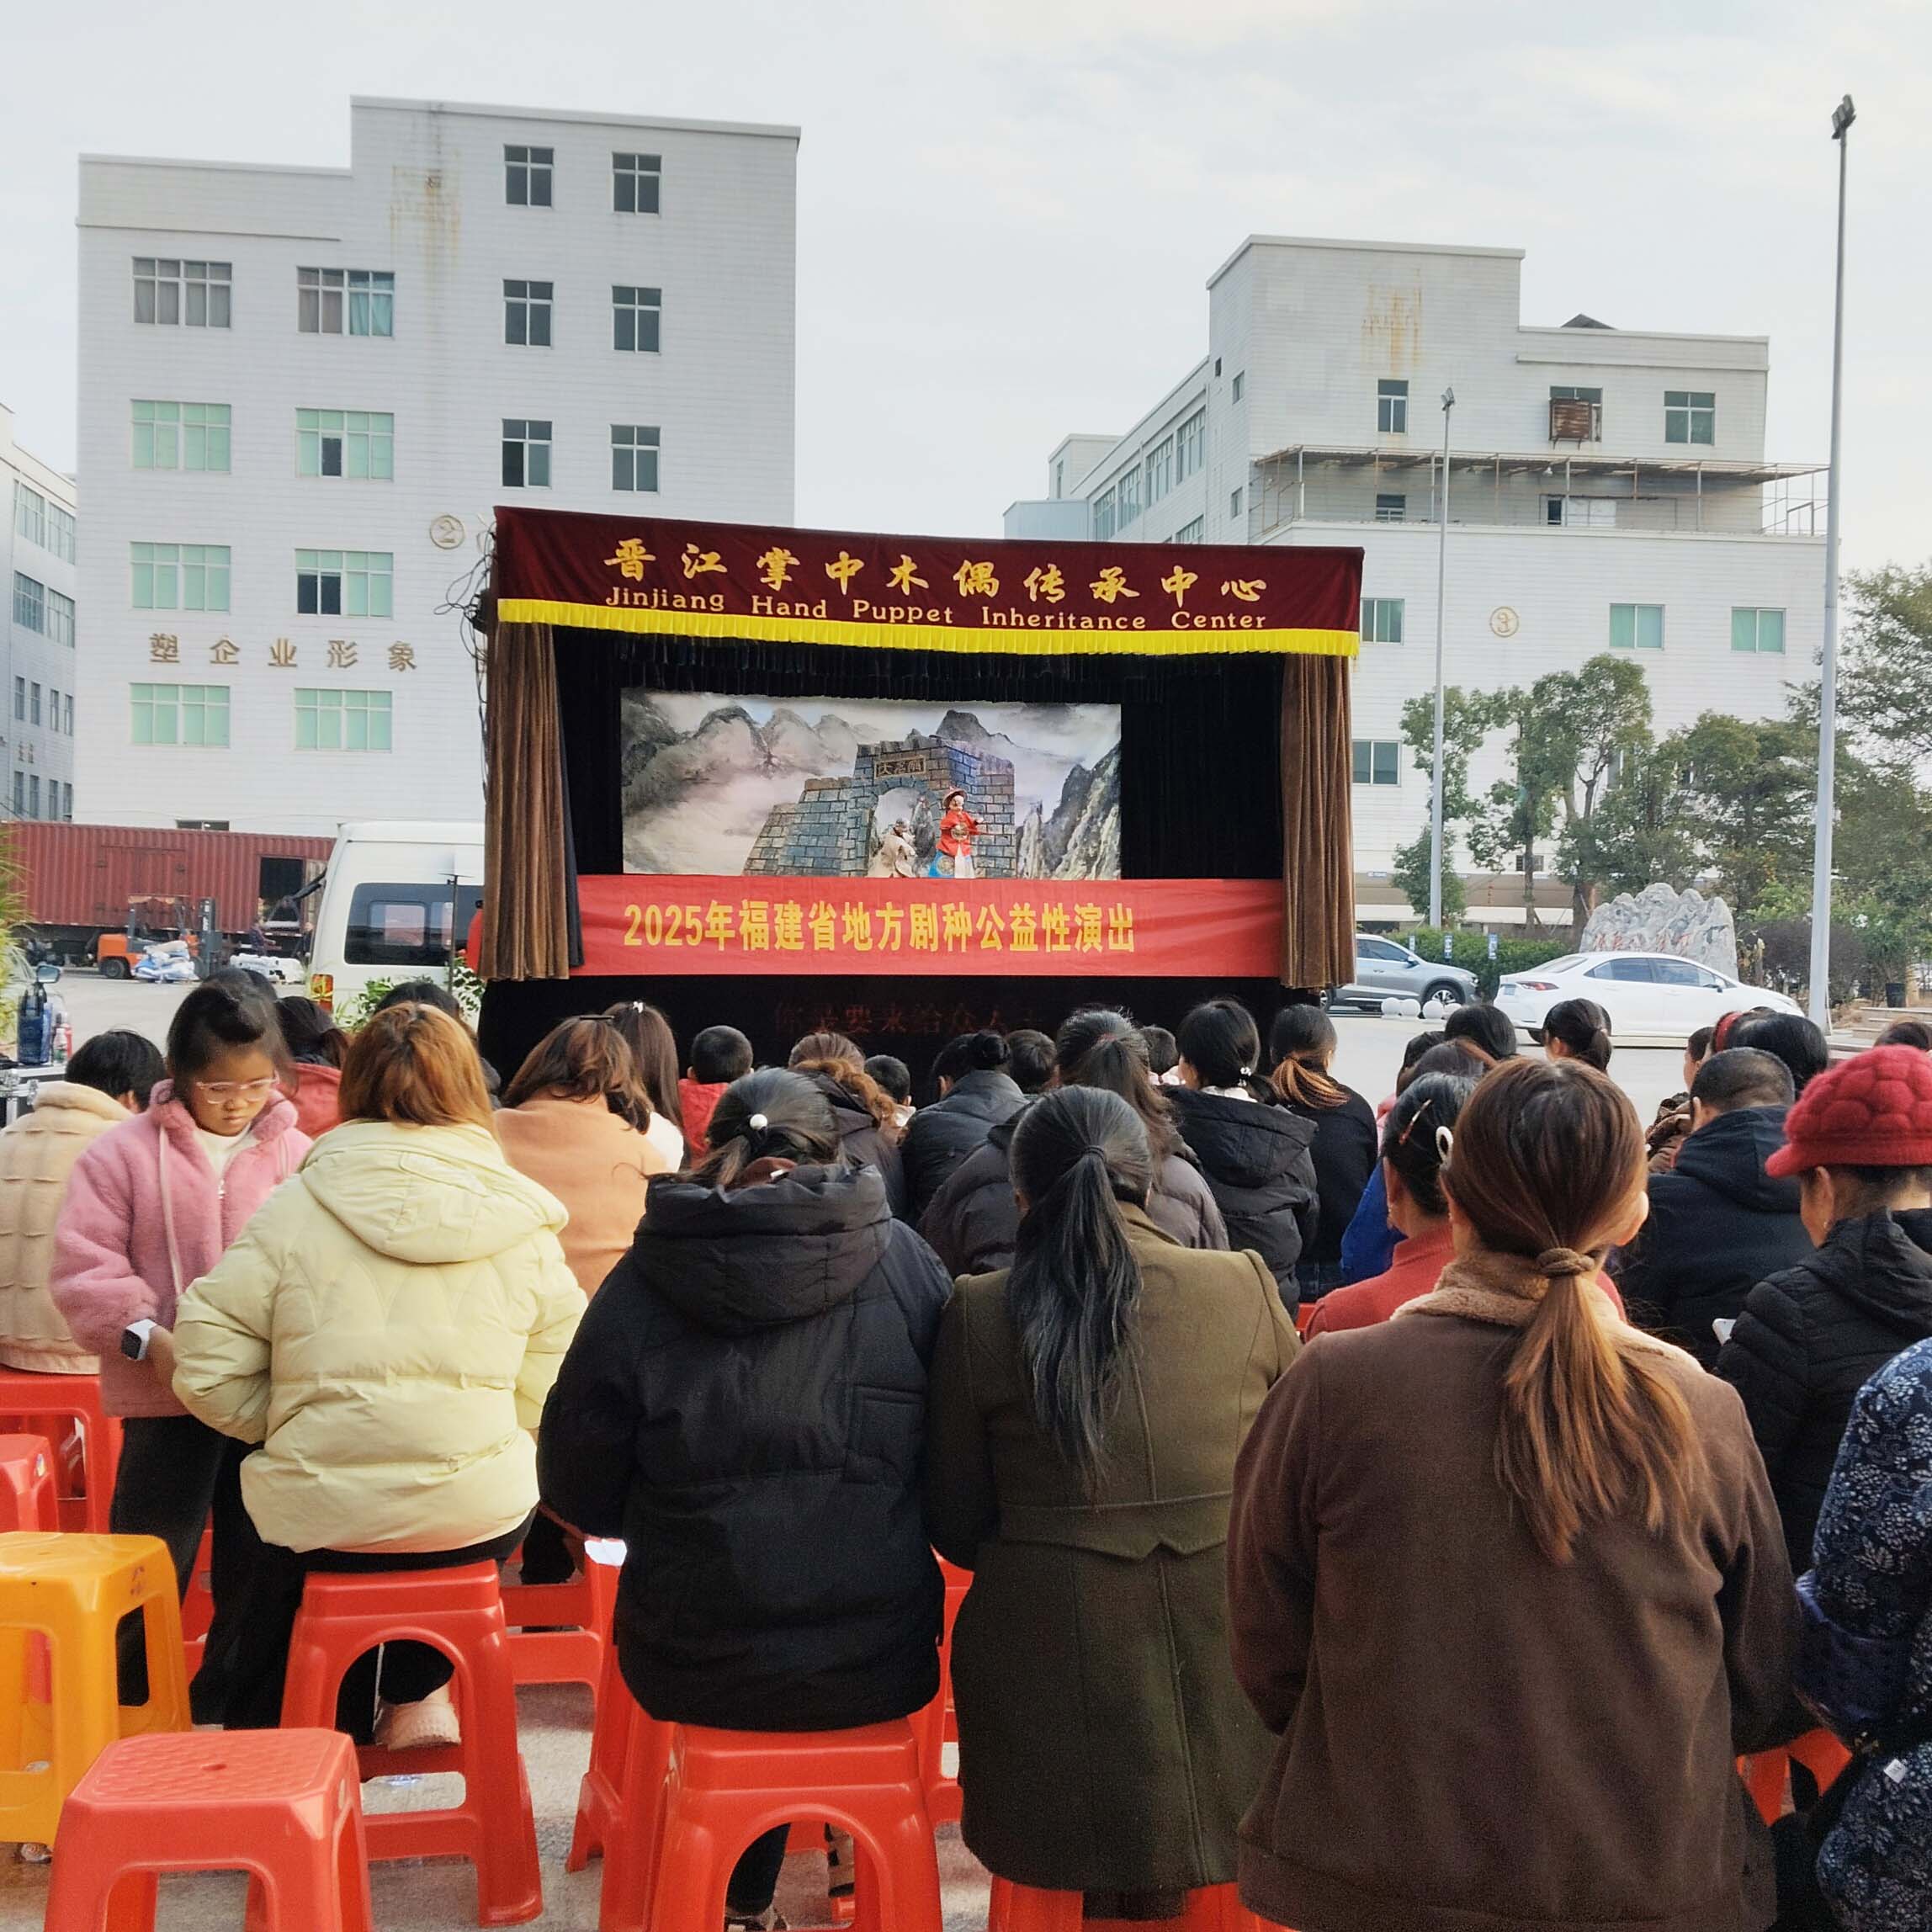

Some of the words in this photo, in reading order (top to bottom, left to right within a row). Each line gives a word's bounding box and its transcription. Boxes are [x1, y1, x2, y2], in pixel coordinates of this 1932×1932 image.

[603, 538, 1267, 608] 晋江掌中木偶传承中心
[605, 586, 724, 612] Jinjiang
[751, 595, 827, 619] Hand
[852, 599, 953, 624] Puppet
[981, 606, 1146, 630] Inheritance
[1171, 611, 1266, 629] Center
[149, 632, 417, 672] 塑企业形象
[624, 899, 1135, 953] 2025年福建省地方剧种公益性演出
